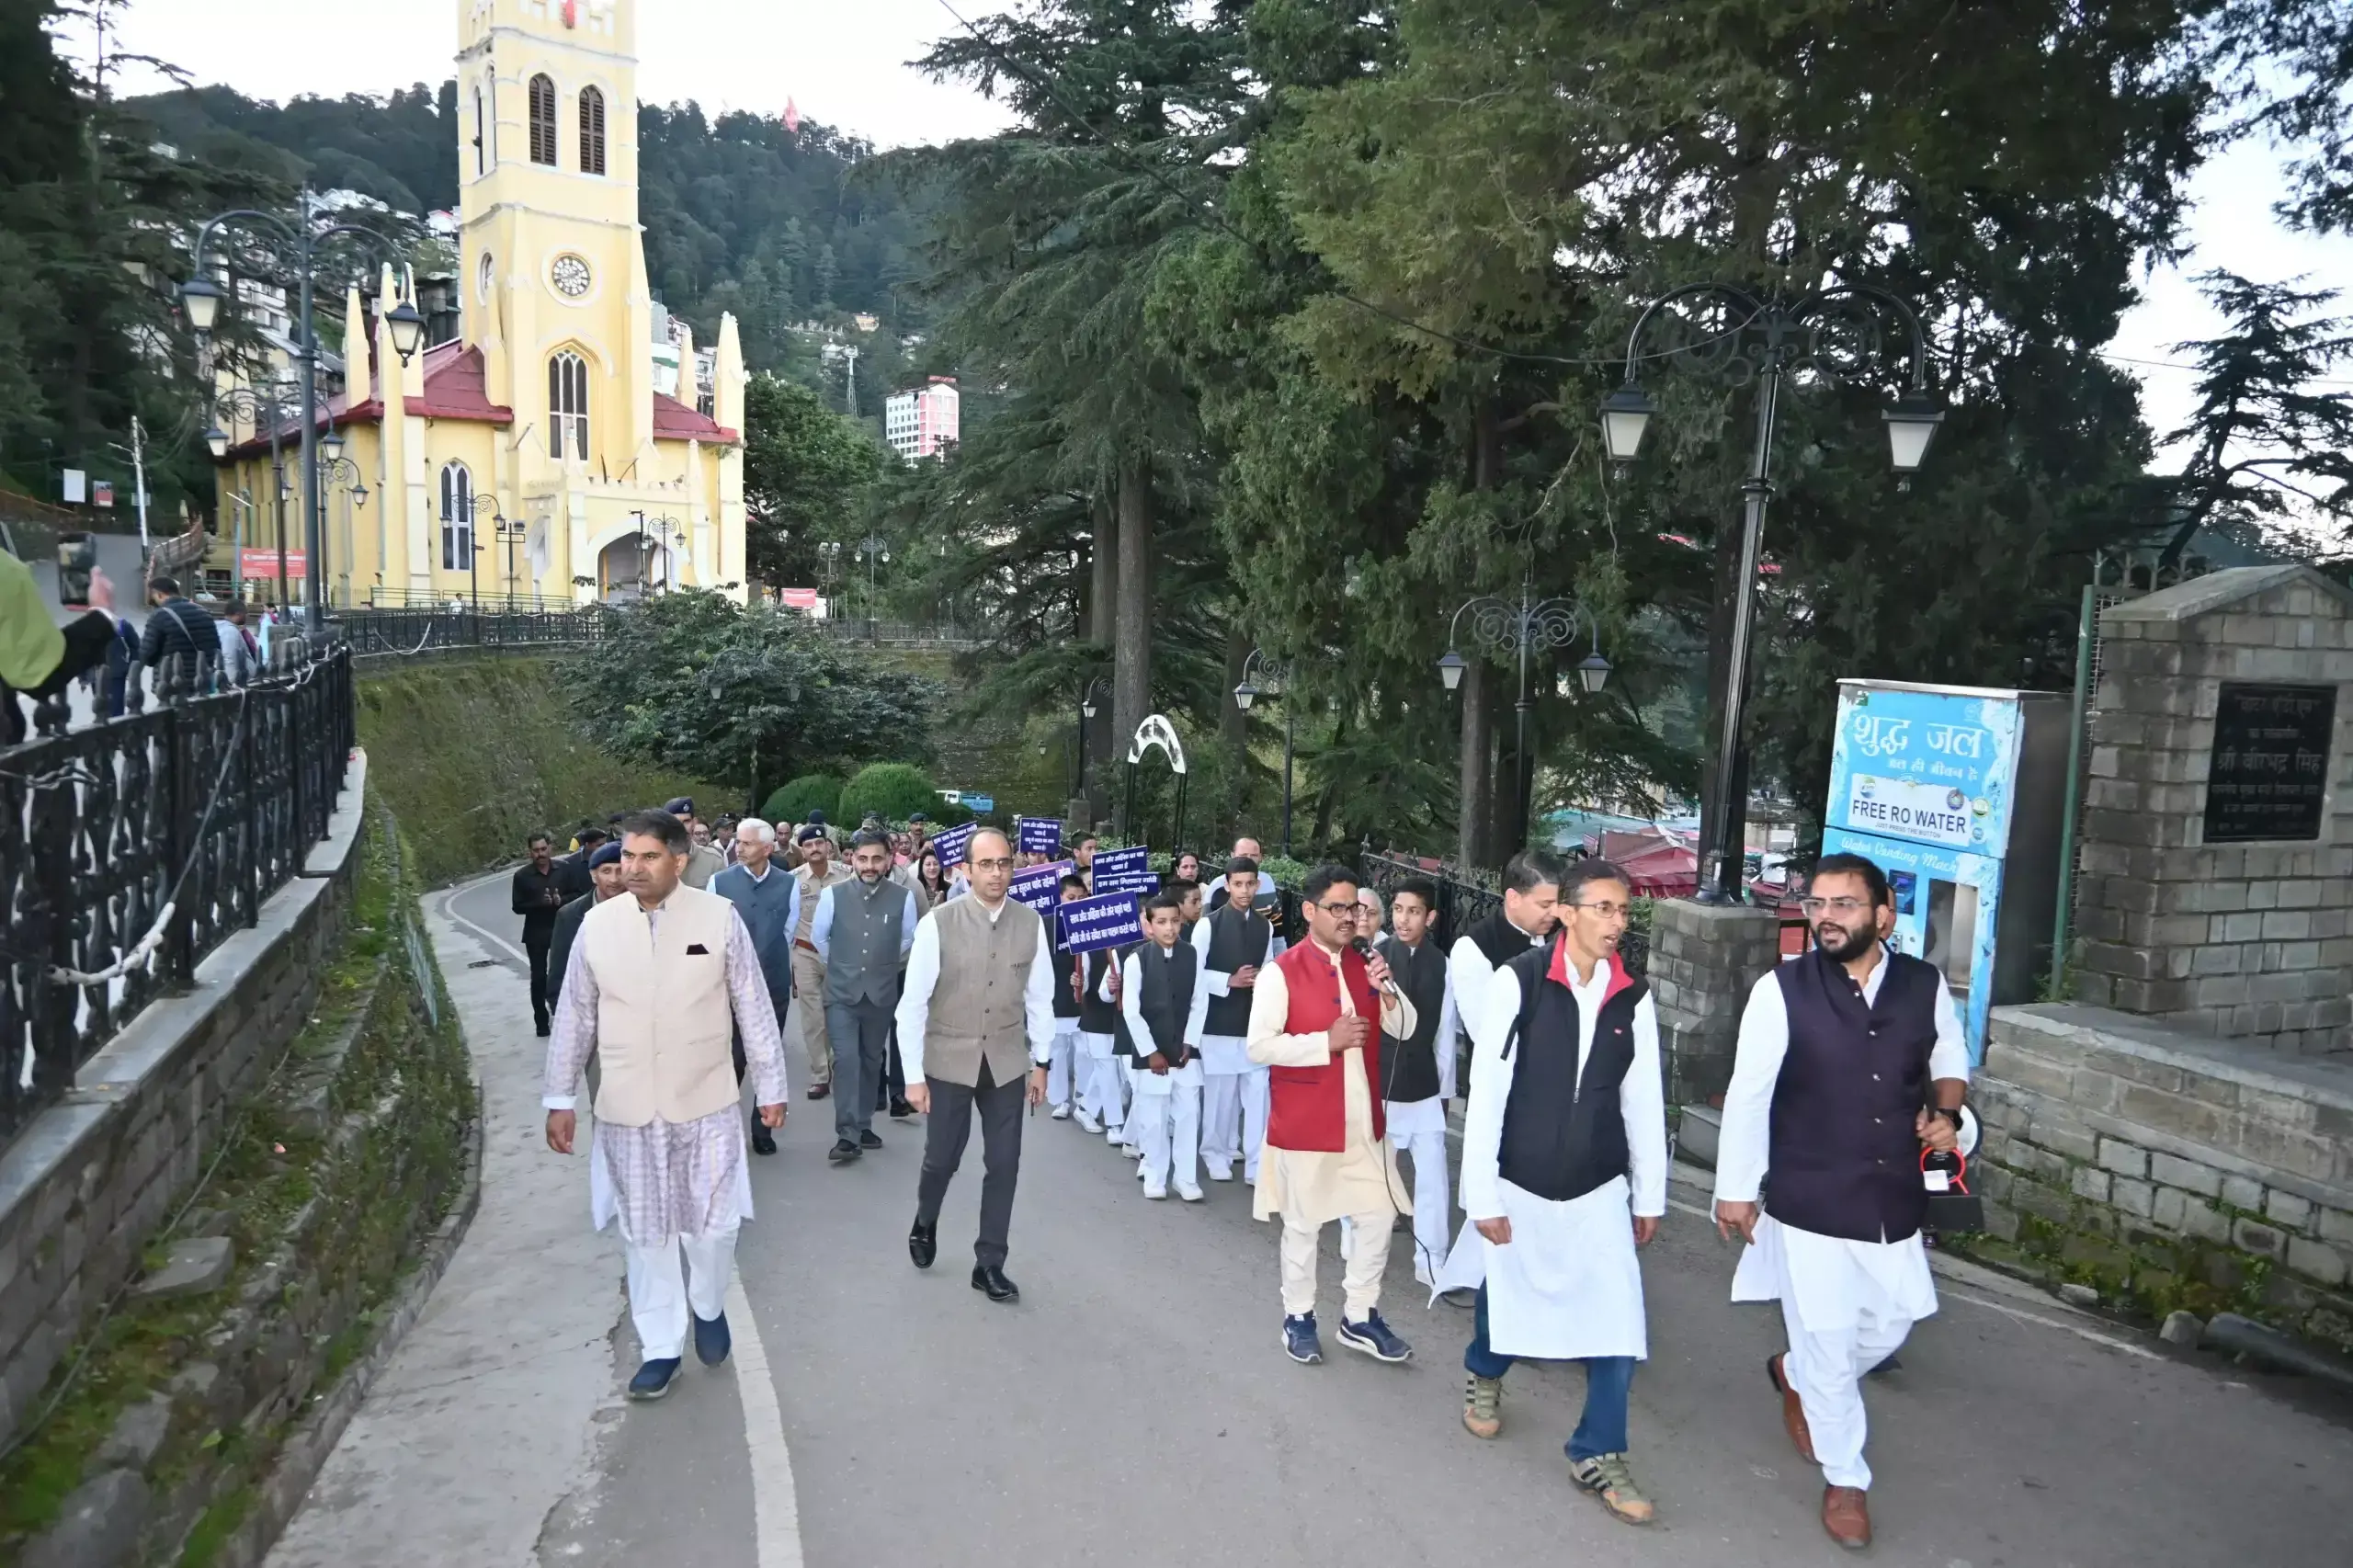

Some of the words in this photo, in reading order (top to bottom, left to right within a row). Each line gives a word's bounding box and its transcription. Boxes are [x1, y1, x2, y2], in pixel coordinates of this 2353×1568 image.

[1853, 714, 1912, 756] शुद्ध
[1927, 722, 1986, 758] जल
[1853, 799, 1887, 820] FREE
[1891, 806, 1910, 824] RO
[1915, 809, 1966, 833] WATER
[1875, 821, 1888, 829] JUST
[1919, 829, 1941, 839] BUTTON
[1841, 837, 1871, 853] Water
[1875, 841, 1919, 867] Vending
[1042, 875, 1056, 887] रहेगा
[1037, 895, 1050, 908] रहेगा
